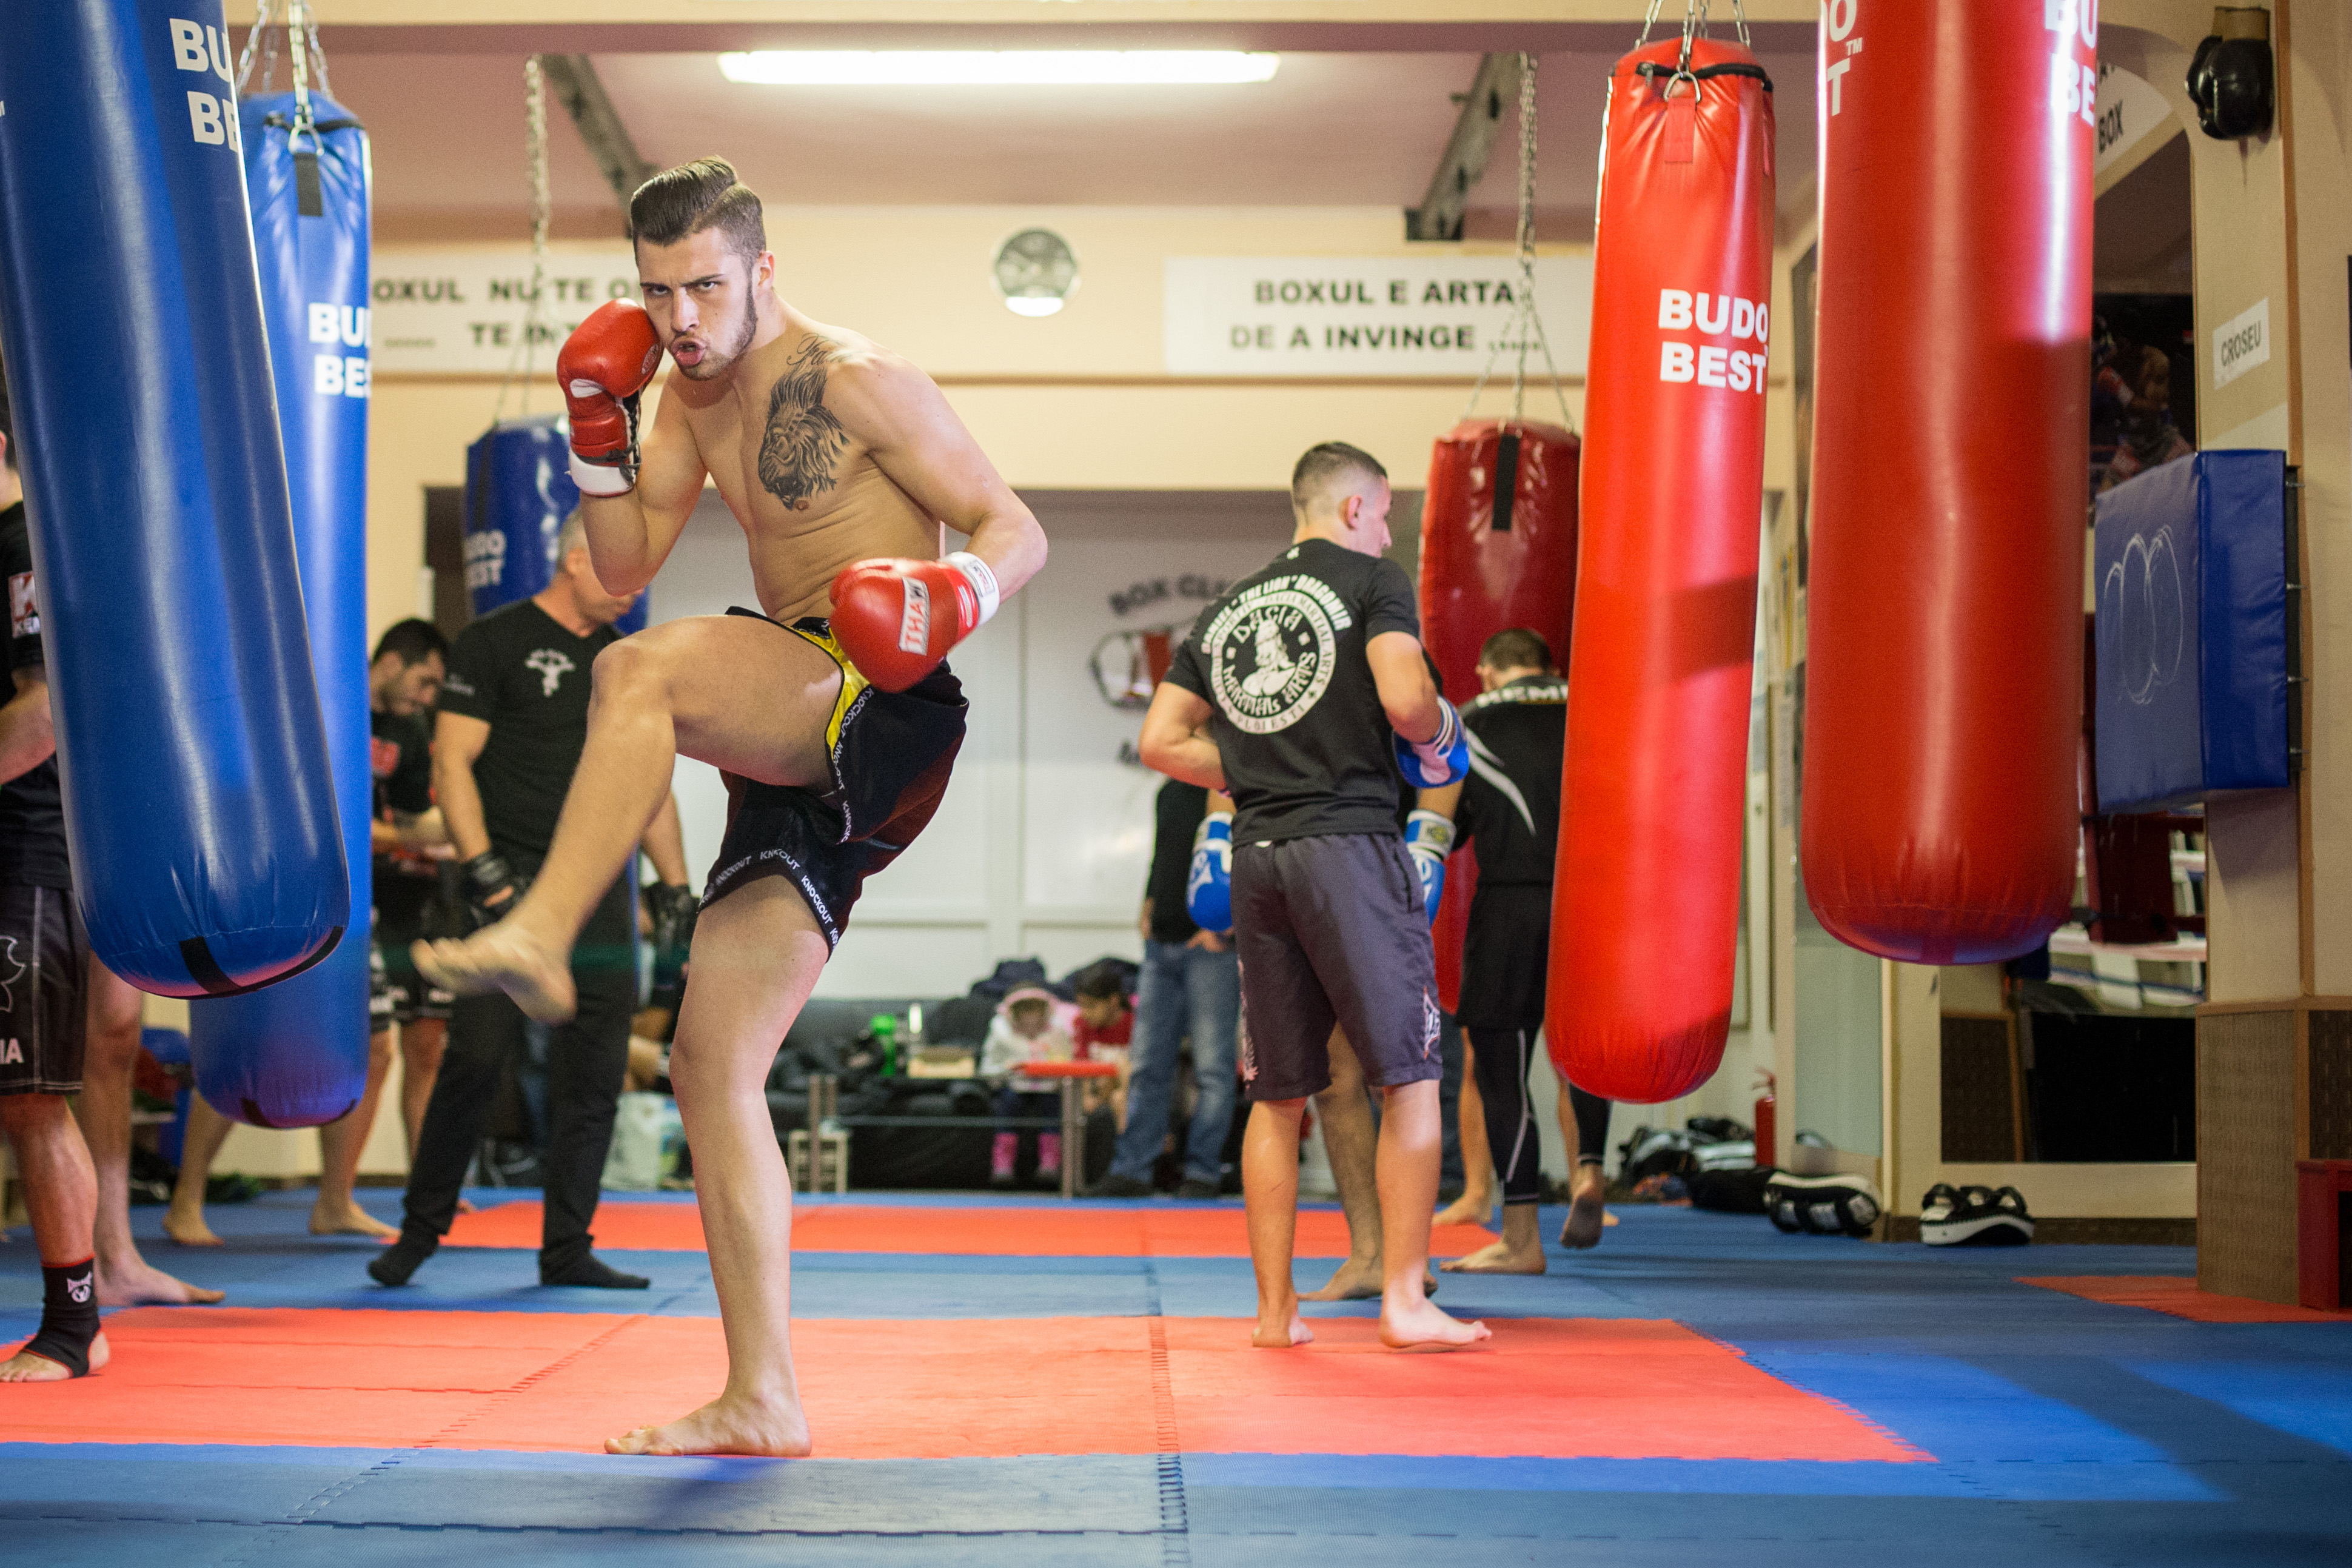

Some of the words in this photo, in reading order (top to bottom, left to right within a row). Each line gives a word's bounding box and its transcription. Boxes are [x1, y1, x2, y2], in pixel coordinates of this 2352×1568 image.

[169, 18, 232, 82] BU
[2051, 53, 2096, 127] BE
[371, 278, 466, 303] OXUL
[489, 277, 540, 301] NU
[552, 277, 593, 301] TE
[1255, 280, 1374, 304] BOXUL
[1388, 280, 1409, 304] E
[1422, 280, 1515, 304] ARTA
[308, 303, 371, 347] BU
[469, 322, 511, 346] TE
[1230, 326, 1276, 350] DE
[1289, 326, 1311, 350] A
[1326, 326, 1476, 350] INVINGE
[1658, 288, 1768, 343] BUDO
[2220, 320, 2262, 366] CROSEU
[314, 354, 371, 398] BE
[1660, 341, 1766, 394] BEST
[1295, 595, 1333, 648] MARTIAL
[1315, 648, 1333, 687] ARTS
[841, 687, 874, 738] KNOCKOUT
[801, 875, 833, 923] KNOCKOUT
